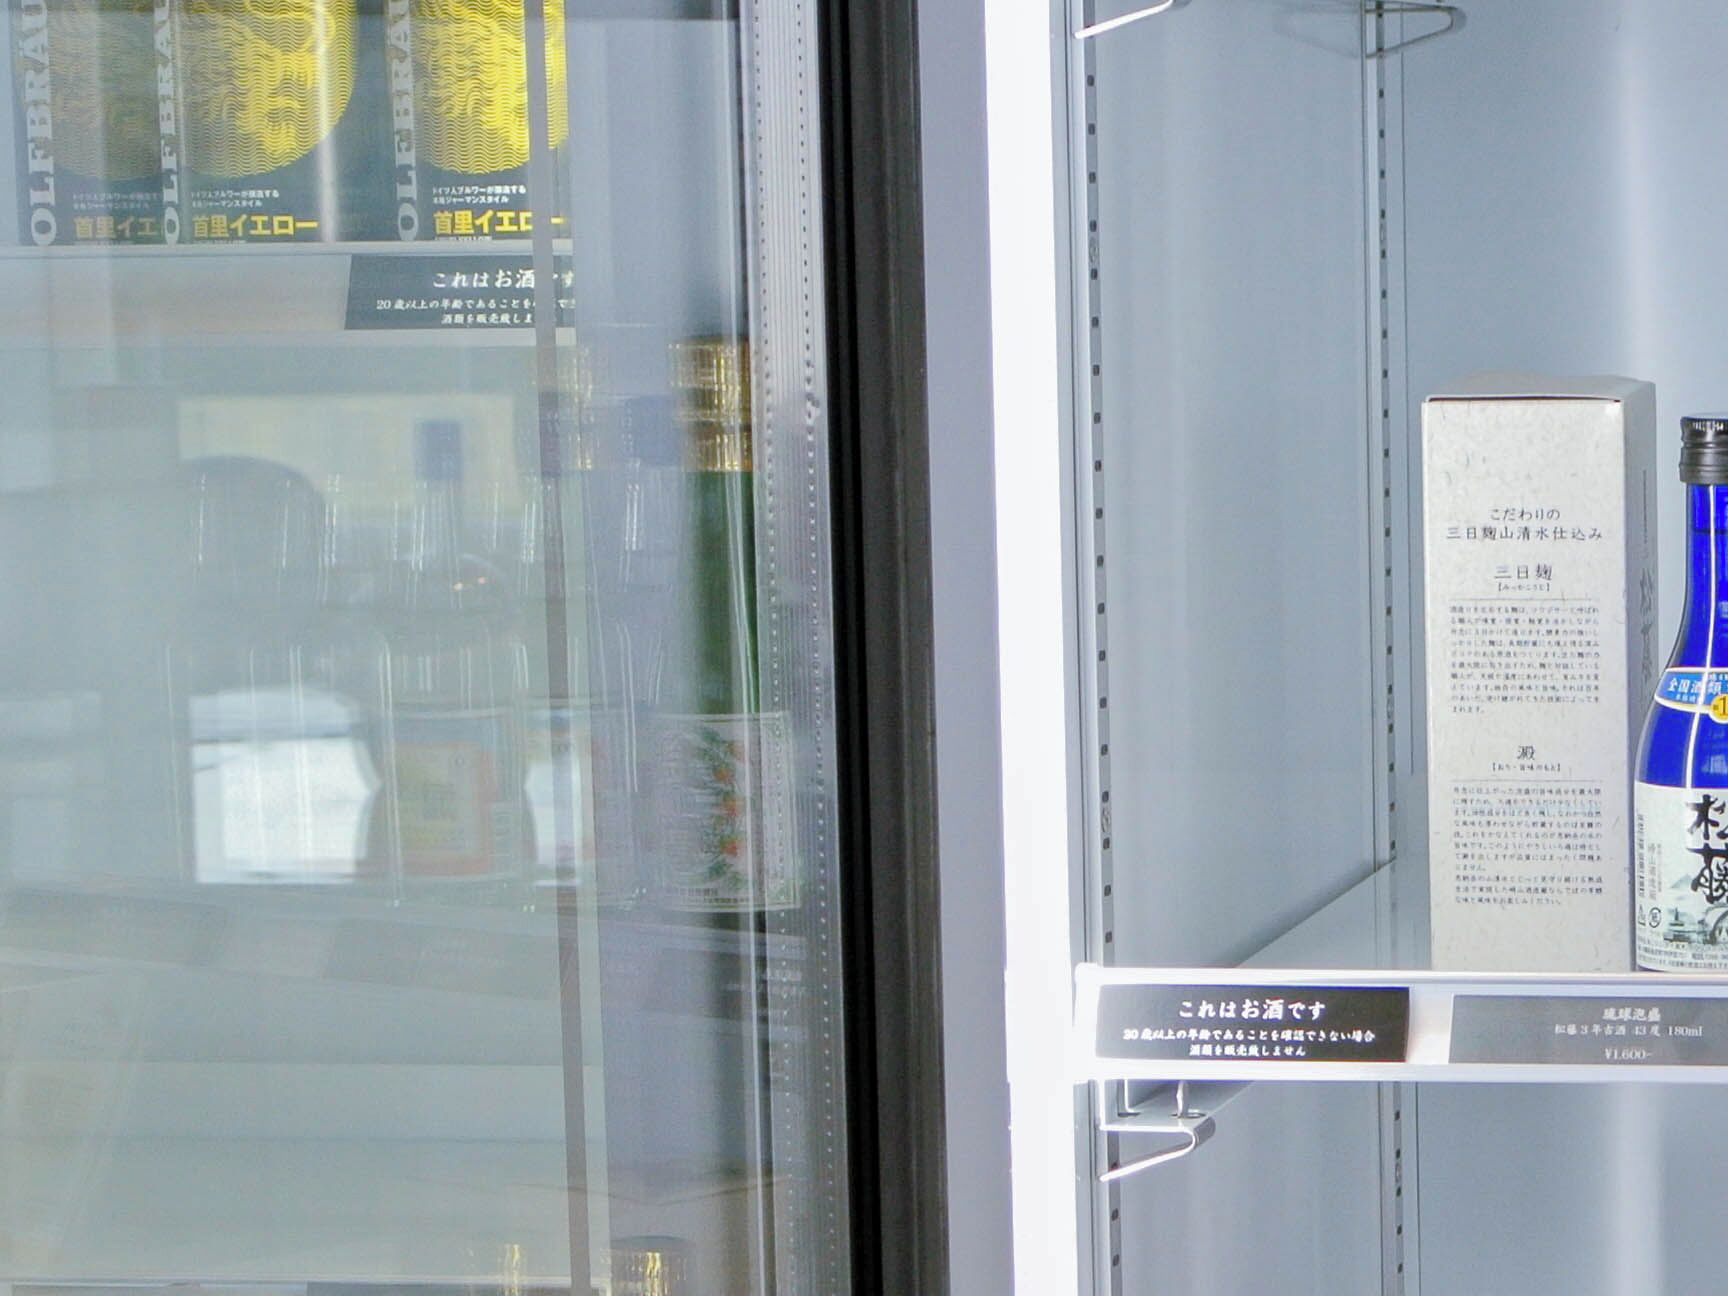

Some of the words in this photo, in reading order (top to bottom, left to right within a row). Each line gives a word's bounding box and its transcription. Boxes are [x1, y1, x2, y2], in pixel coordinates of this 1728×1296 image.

[73, 217, 163, 240] 首里イエ
[193, 214, 318, 237] 首里イエロー
[433, 269, 574, 288] これはお酒す
[1490, 508, 1561, 521] こだわりの
[1178, 998, 1326, 1021] これはお酒です
[1602, 1007, 1662, 1022] 琉球泡盛
